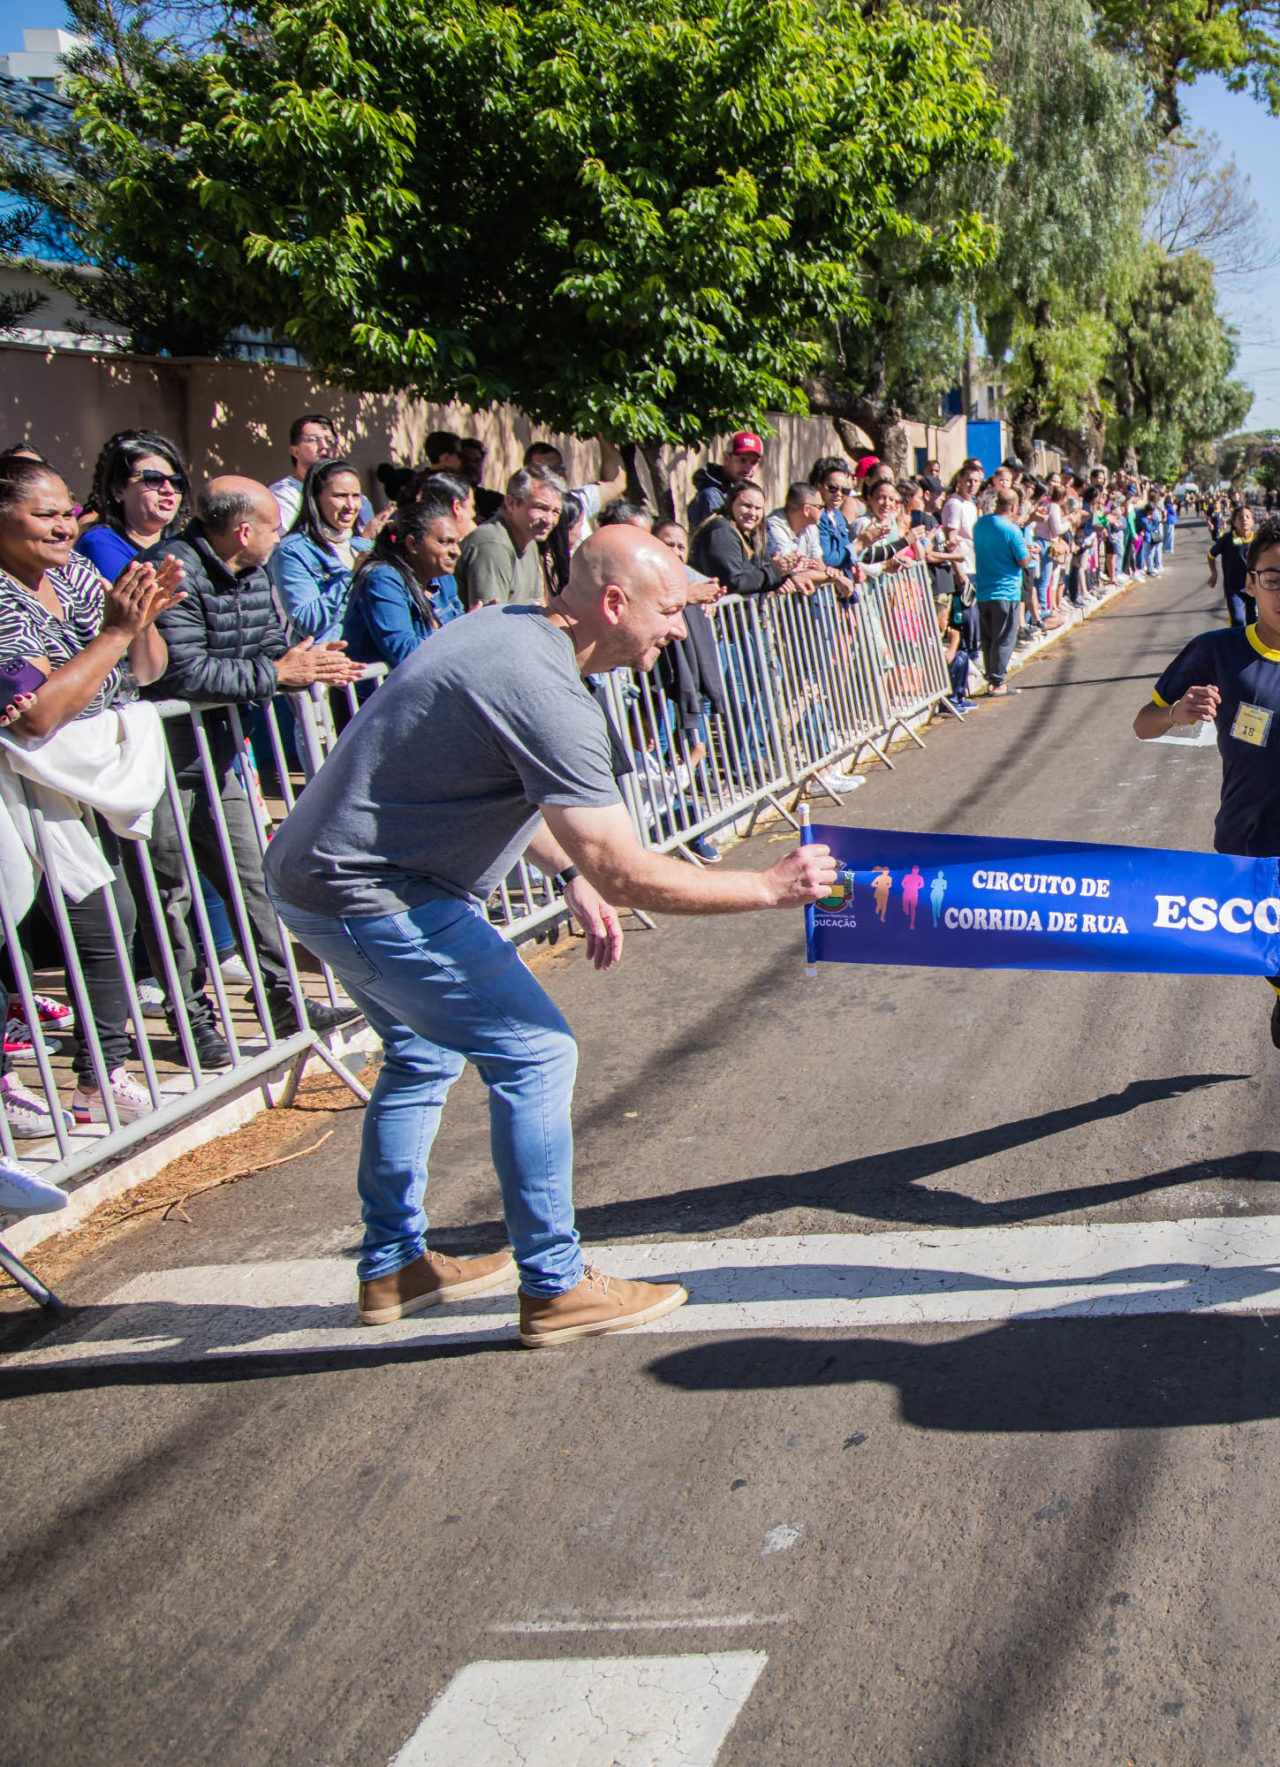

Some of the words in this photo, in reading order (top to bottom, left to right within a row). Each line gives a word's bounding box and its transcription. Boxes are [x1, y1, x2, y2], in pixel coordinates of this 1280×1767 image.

[971, 869, 1075, 896] CIRCUITO
[1079, 877, 1111, 899] DE
[812, 918, 857, 929] DUCAÇÃO
[944, 907, 1043, 932] CORRIDA
[1046, 911, 1078, 933] DE
[1081, 913, 1129, 936] RUA
